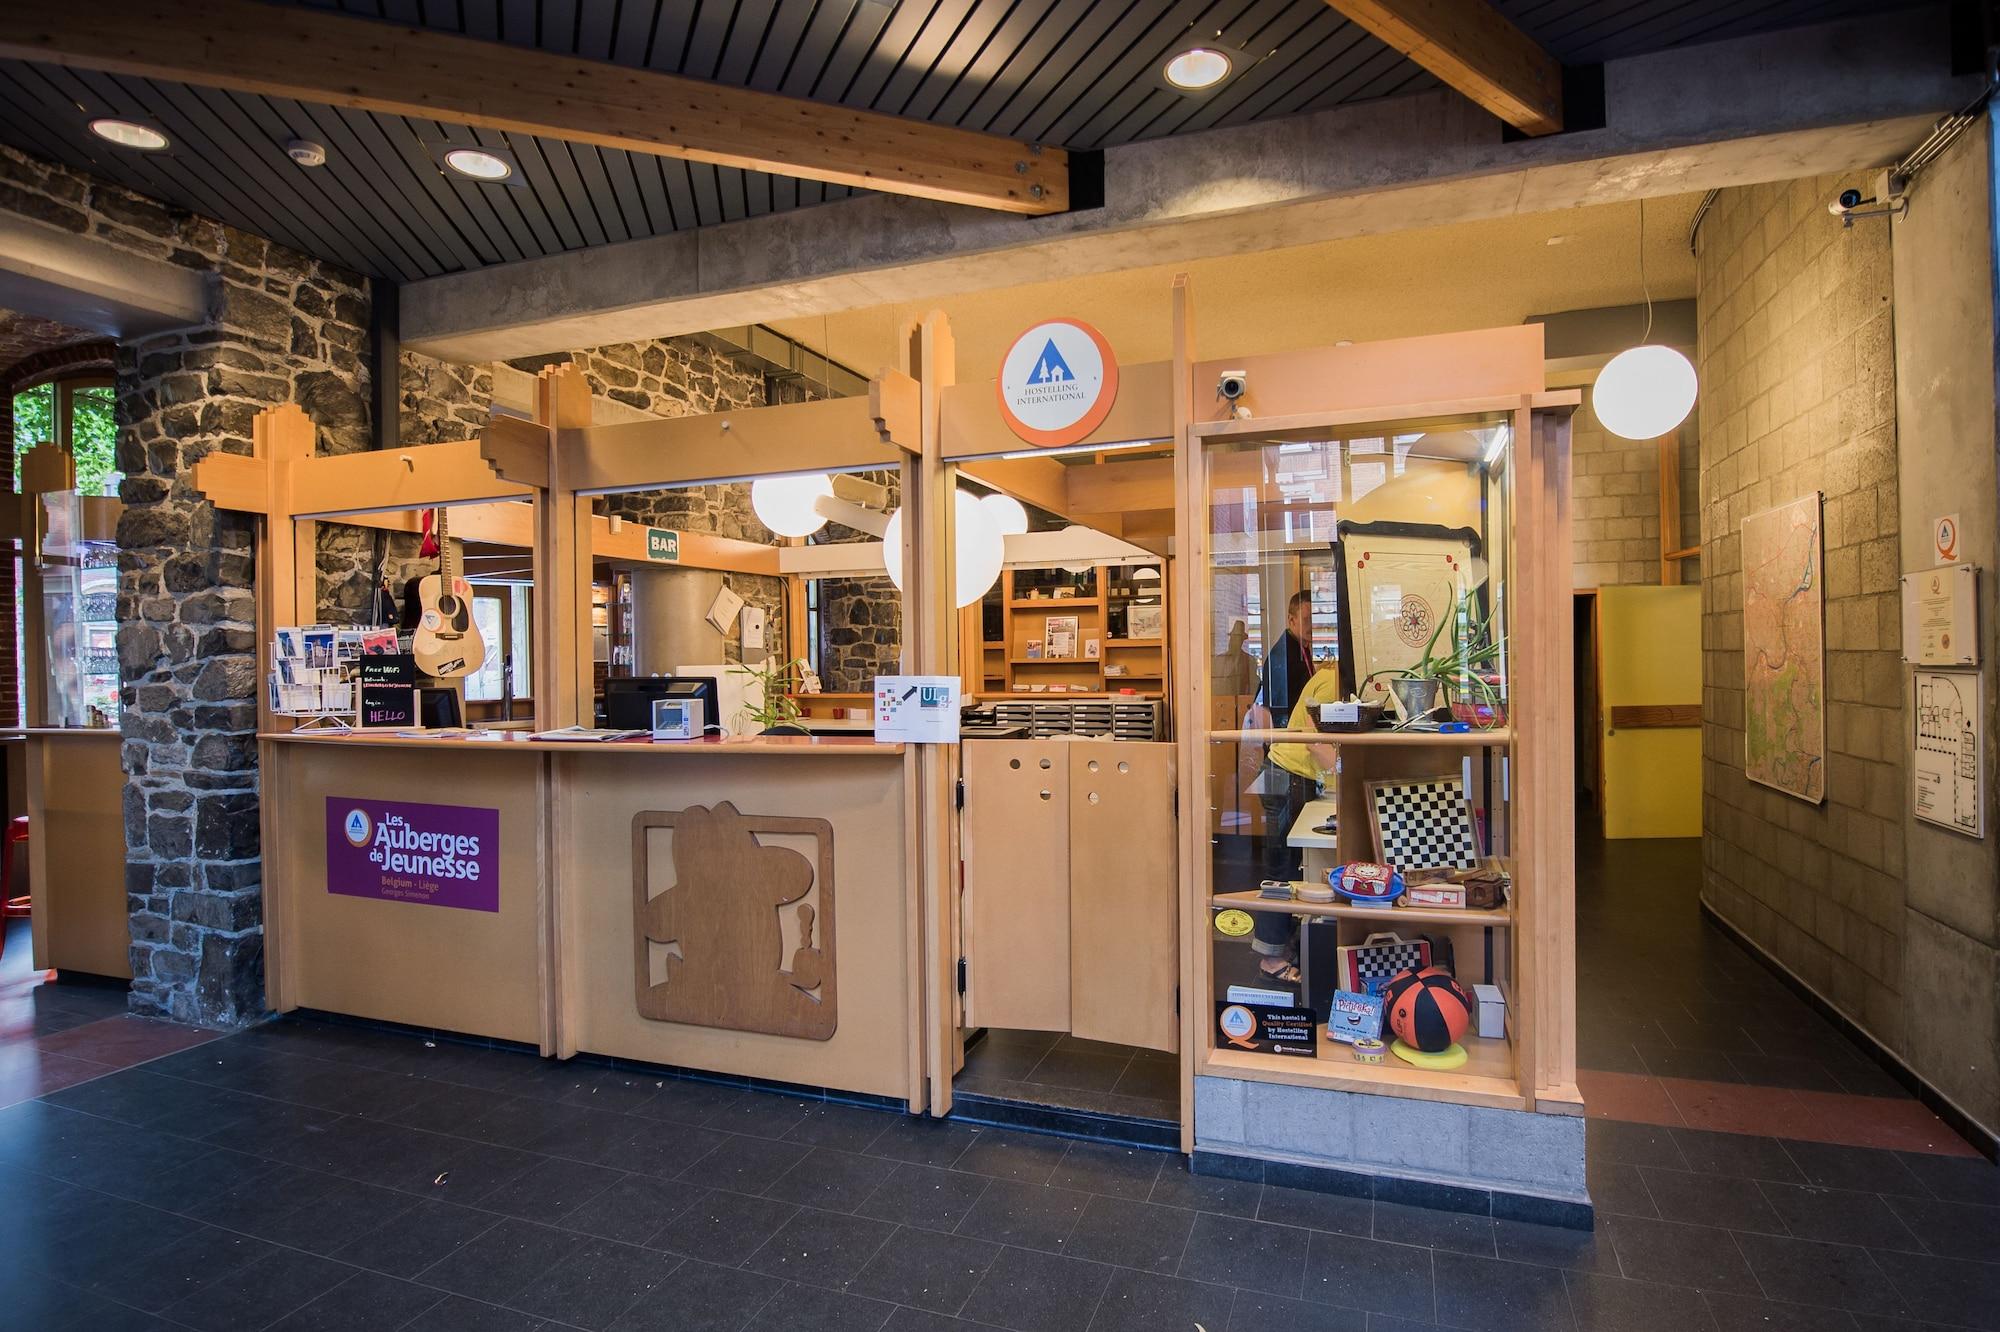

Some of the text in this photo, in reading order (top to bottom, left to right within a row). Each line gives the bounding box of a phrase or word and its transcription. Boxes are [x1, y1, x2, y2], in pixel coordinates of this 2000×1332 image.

[1024, 384, 1079, 396] HOSTELLING
[1017, 392, 1085, 405] INTERNATIONAL
[651, 536, 677, 552] BAR
[370, 710, 405, 722] HELLO
[386, 812, 403, 826] Les
[374, 822, 480, 860] Auberges
[369, 846, 480, 881] de Jeunesse
[381, 876, 412, 889] Belgium
[418, 877, 439, 893] Liège
[381, 887, 430, 900] Georges Simenon
[1262, 1020, 1285, 1028] Quality
[1276, 1027, 1308, 1035] Hostelling
